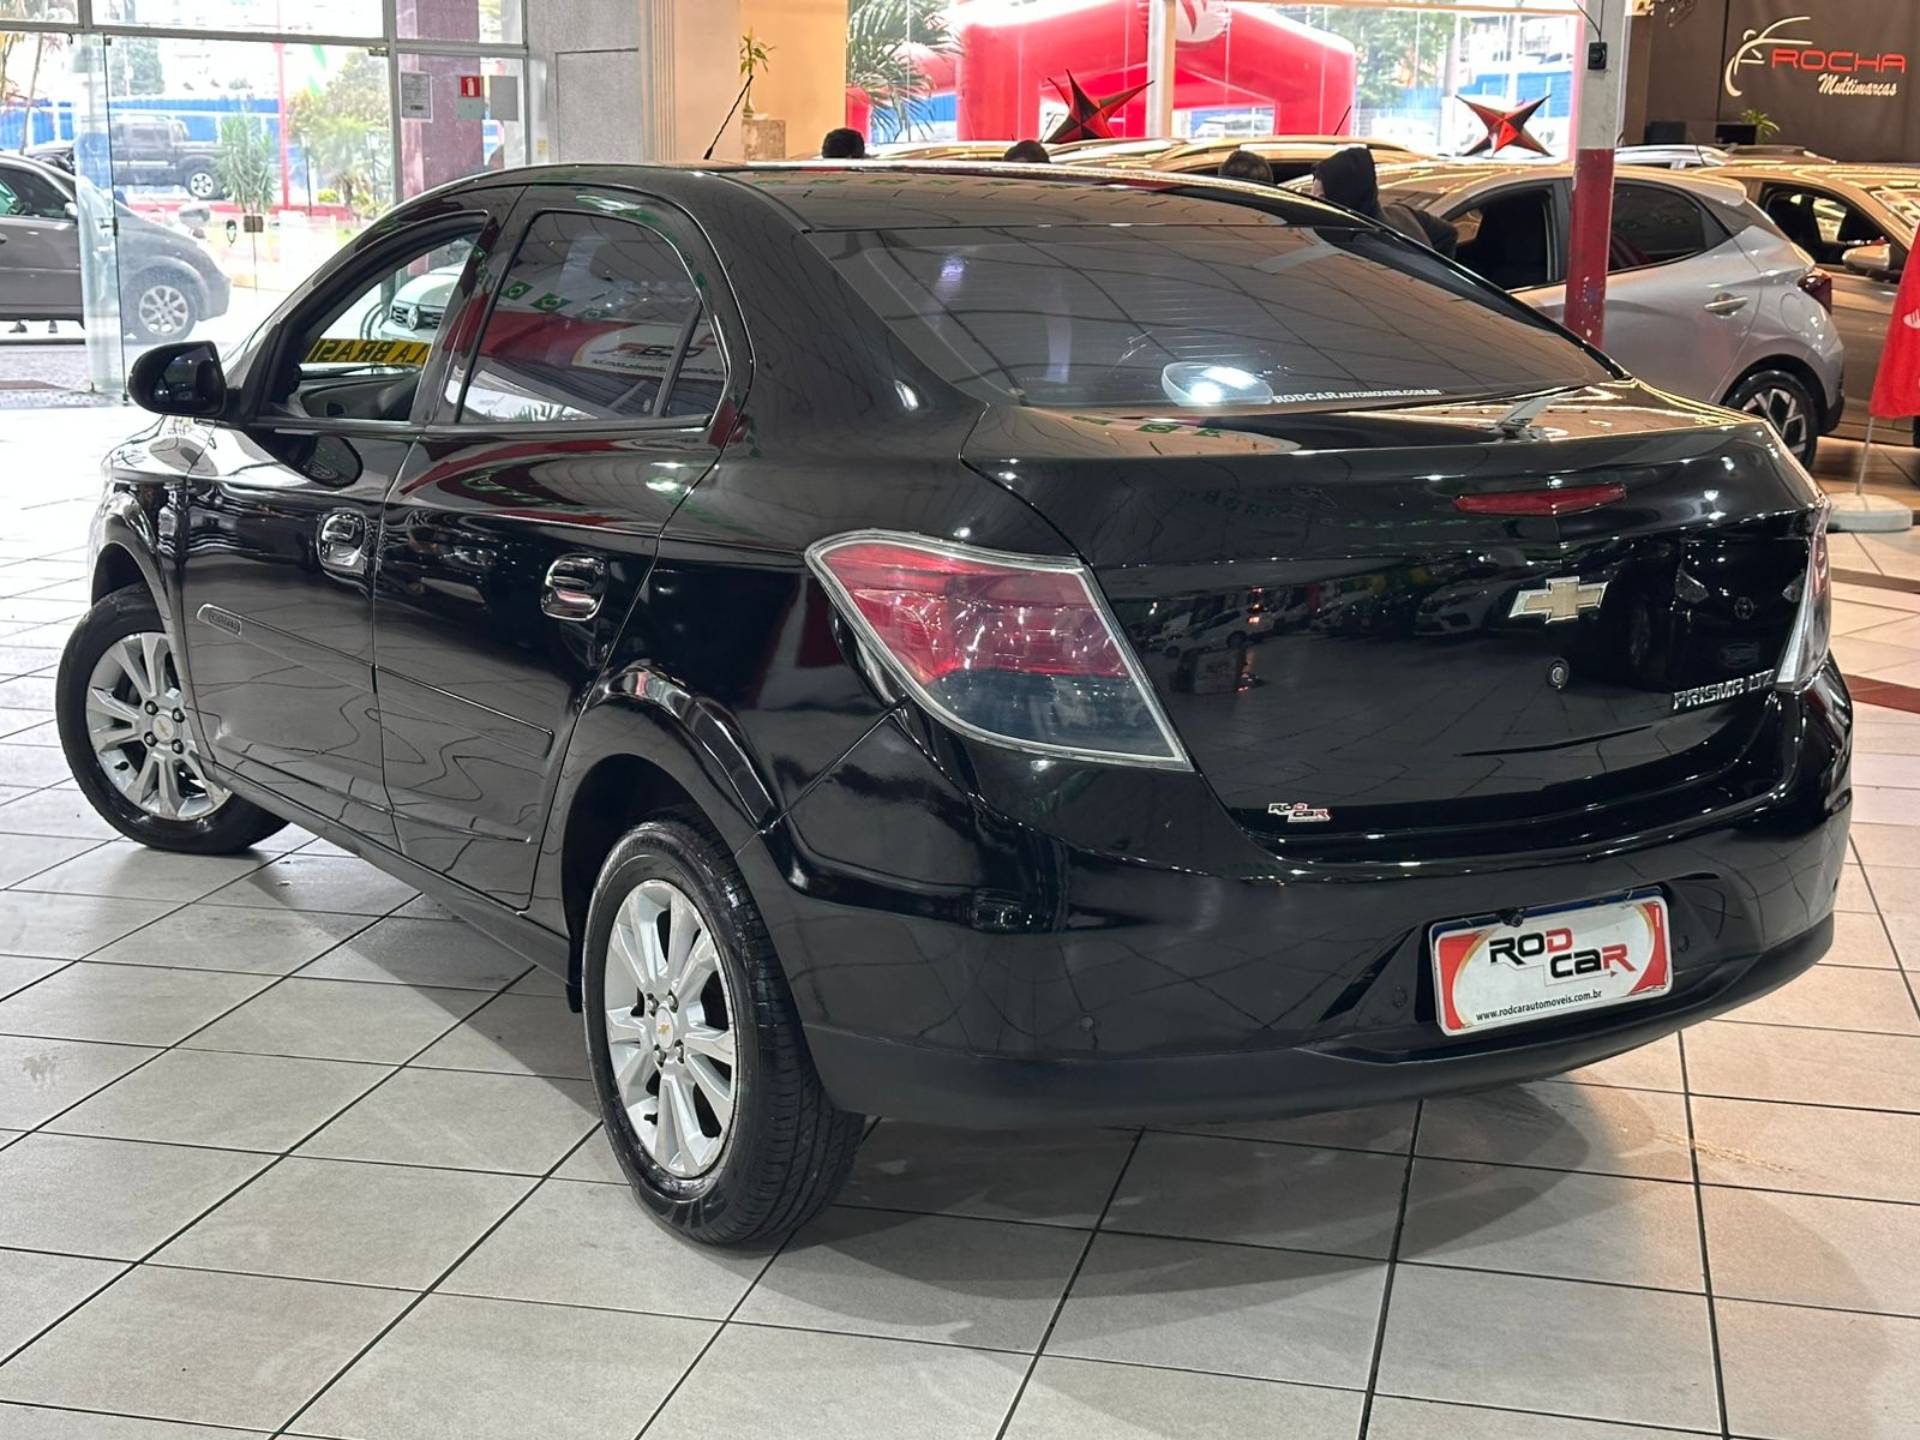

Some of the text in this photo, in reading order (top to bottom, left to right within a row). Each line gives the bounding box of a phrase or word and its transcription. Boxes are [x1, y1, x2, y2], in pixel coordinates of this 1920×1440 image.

[1771, 48, 1906, 73] ROCHA
[1817, 73, 1897, 96] Multimarcas
[1673, 678, 1744, 710] PRISMA
[1489, 927, 1574, 966] ROD
[1476, 989, 1603, 1022] www.rodcarautomoveis.com.br
